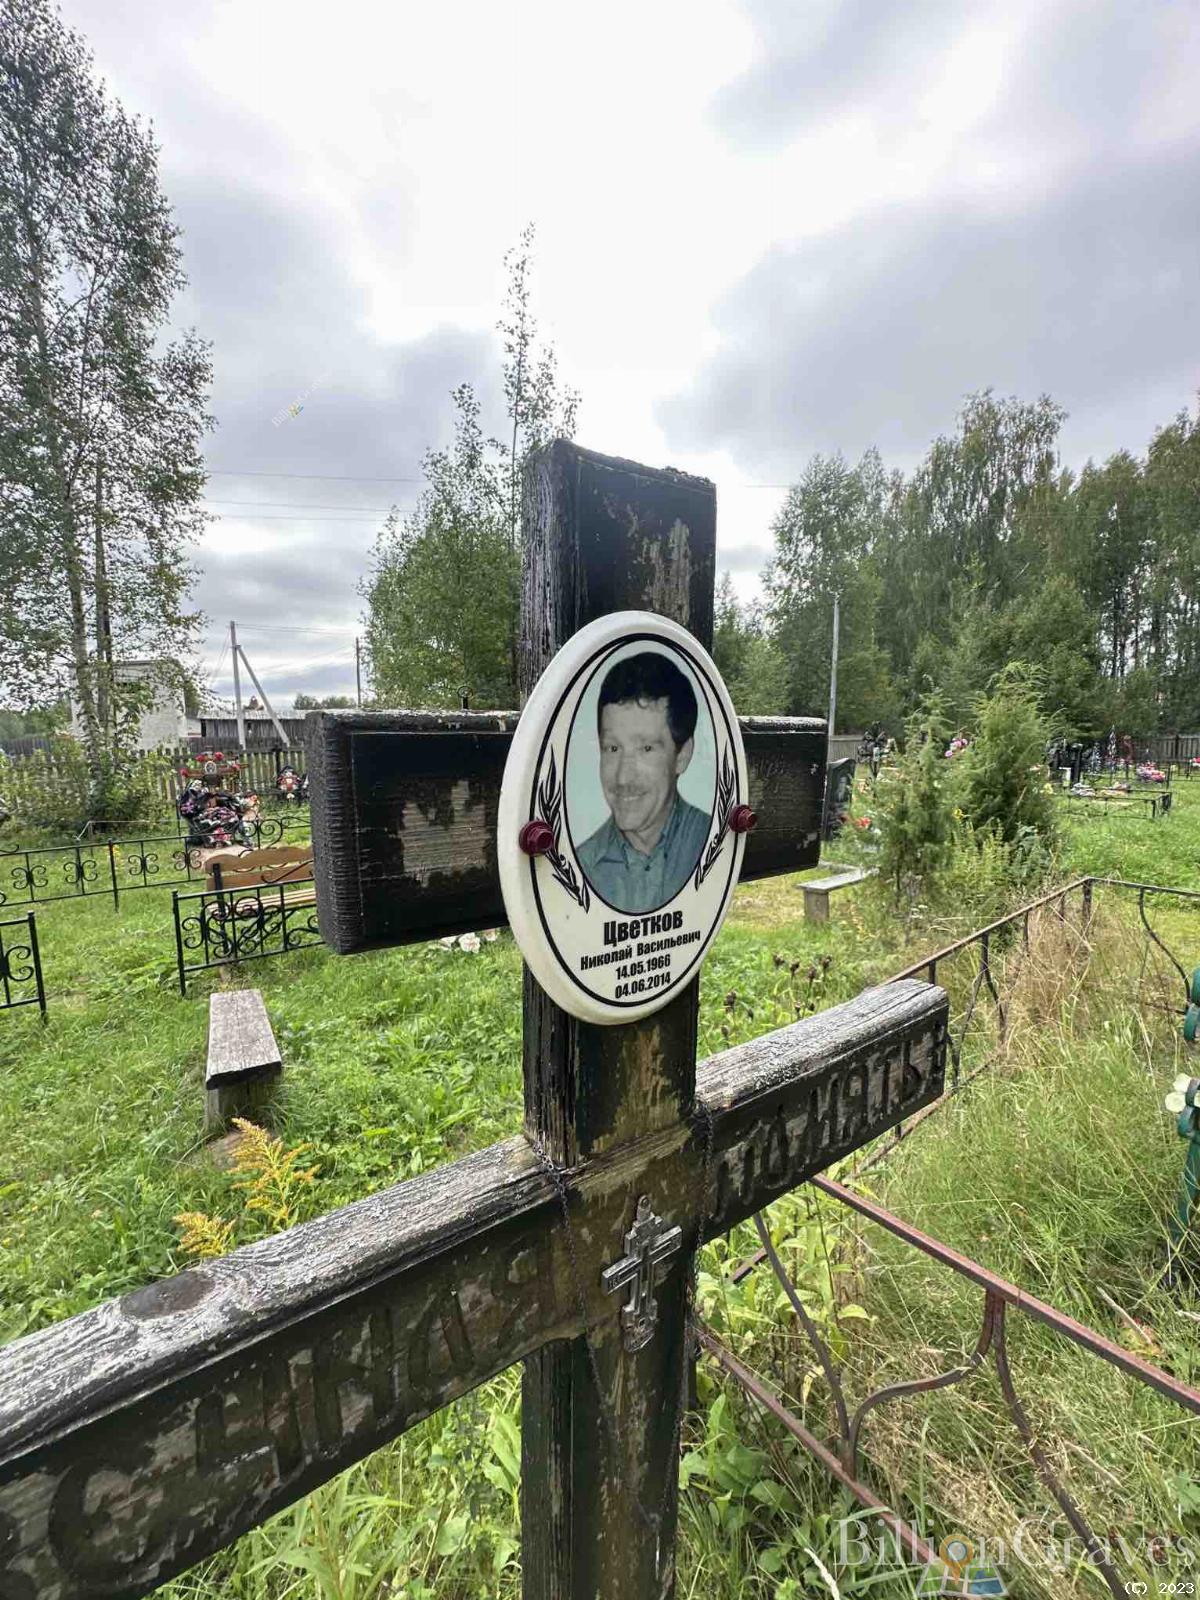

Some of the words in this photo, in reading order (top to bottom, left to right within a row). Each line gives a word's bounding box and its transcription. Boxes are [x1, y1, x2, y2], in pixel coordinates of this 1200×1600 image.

[603, 910, 683, 947] Цветков
[580, 945, 633, 971] Николай
[636, 930, 701, 957] Васильевич
[615, 953, 671, 980] 14.05.1966
[614, 971, 671, 999] 04.06.2014
